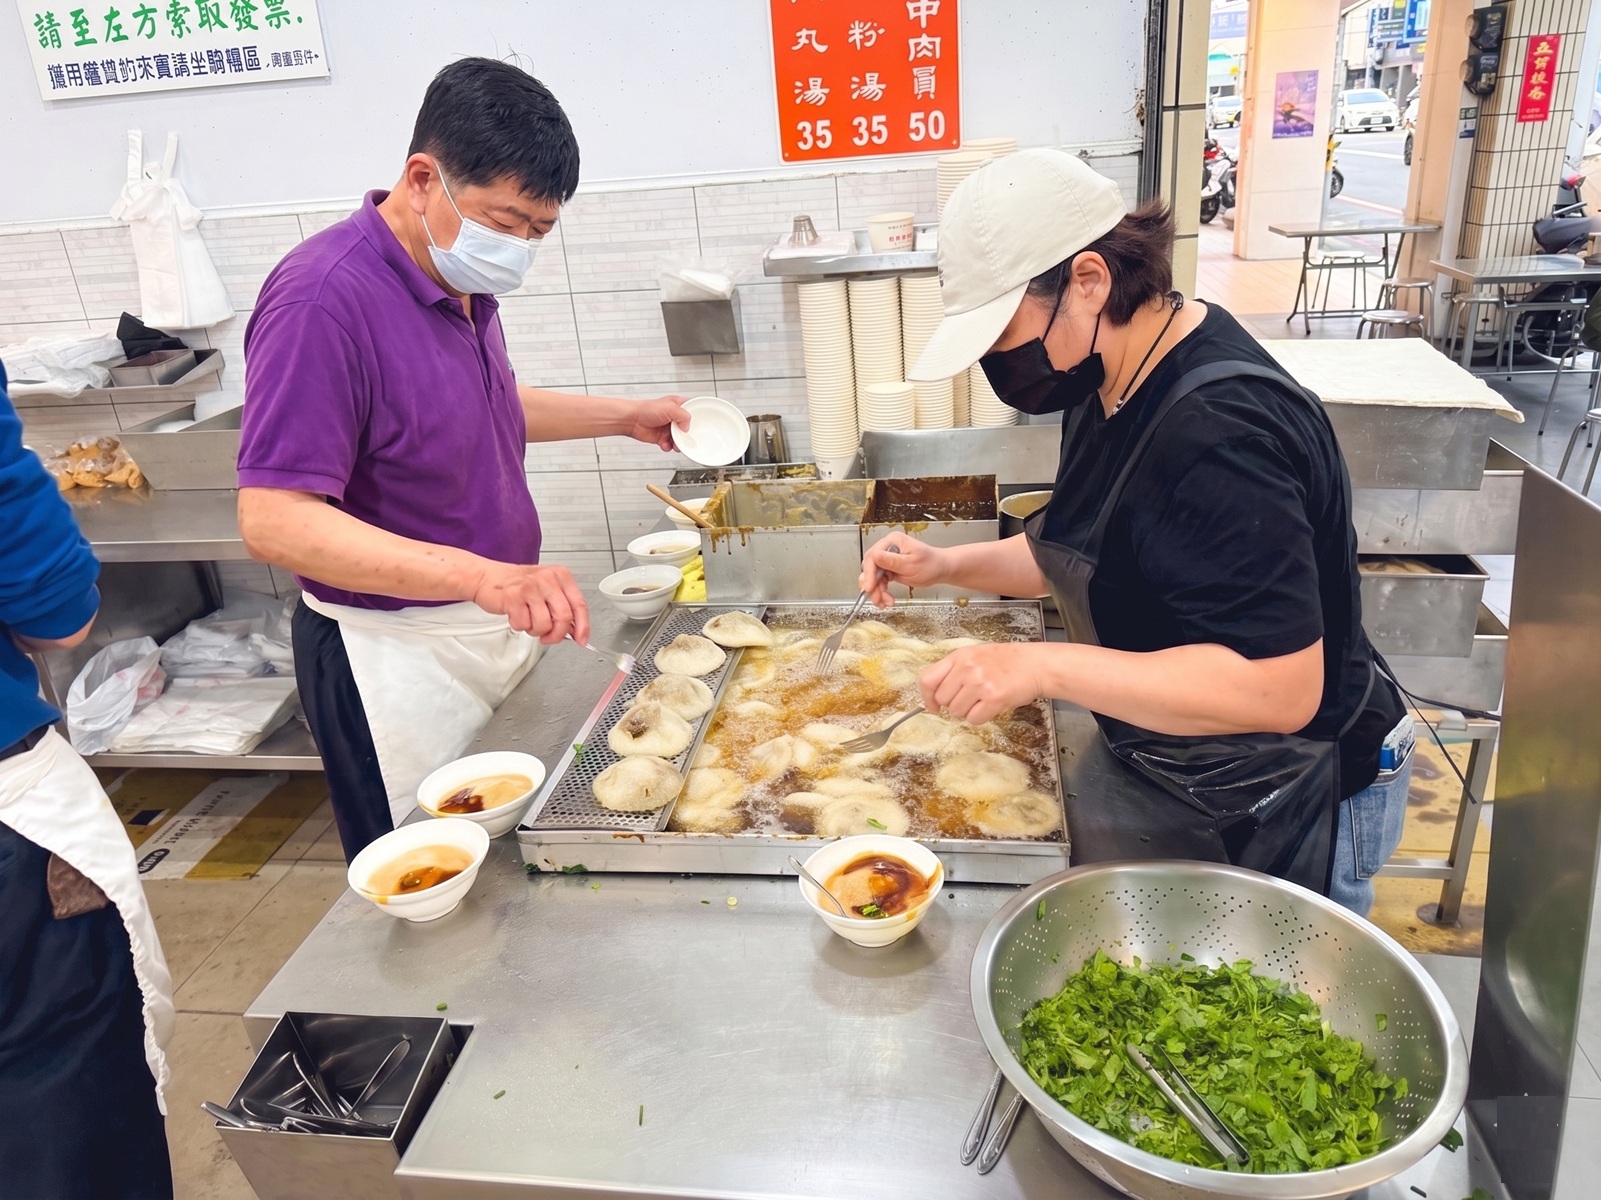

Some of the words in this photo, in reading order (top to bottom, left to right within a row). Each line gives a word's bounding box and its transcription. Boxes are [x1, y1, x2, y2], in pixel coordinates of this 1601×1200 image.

[796, 119, 833, 150] 35
[852, 114, 889, 146] 35
[908, 109, 945, 142] 50
